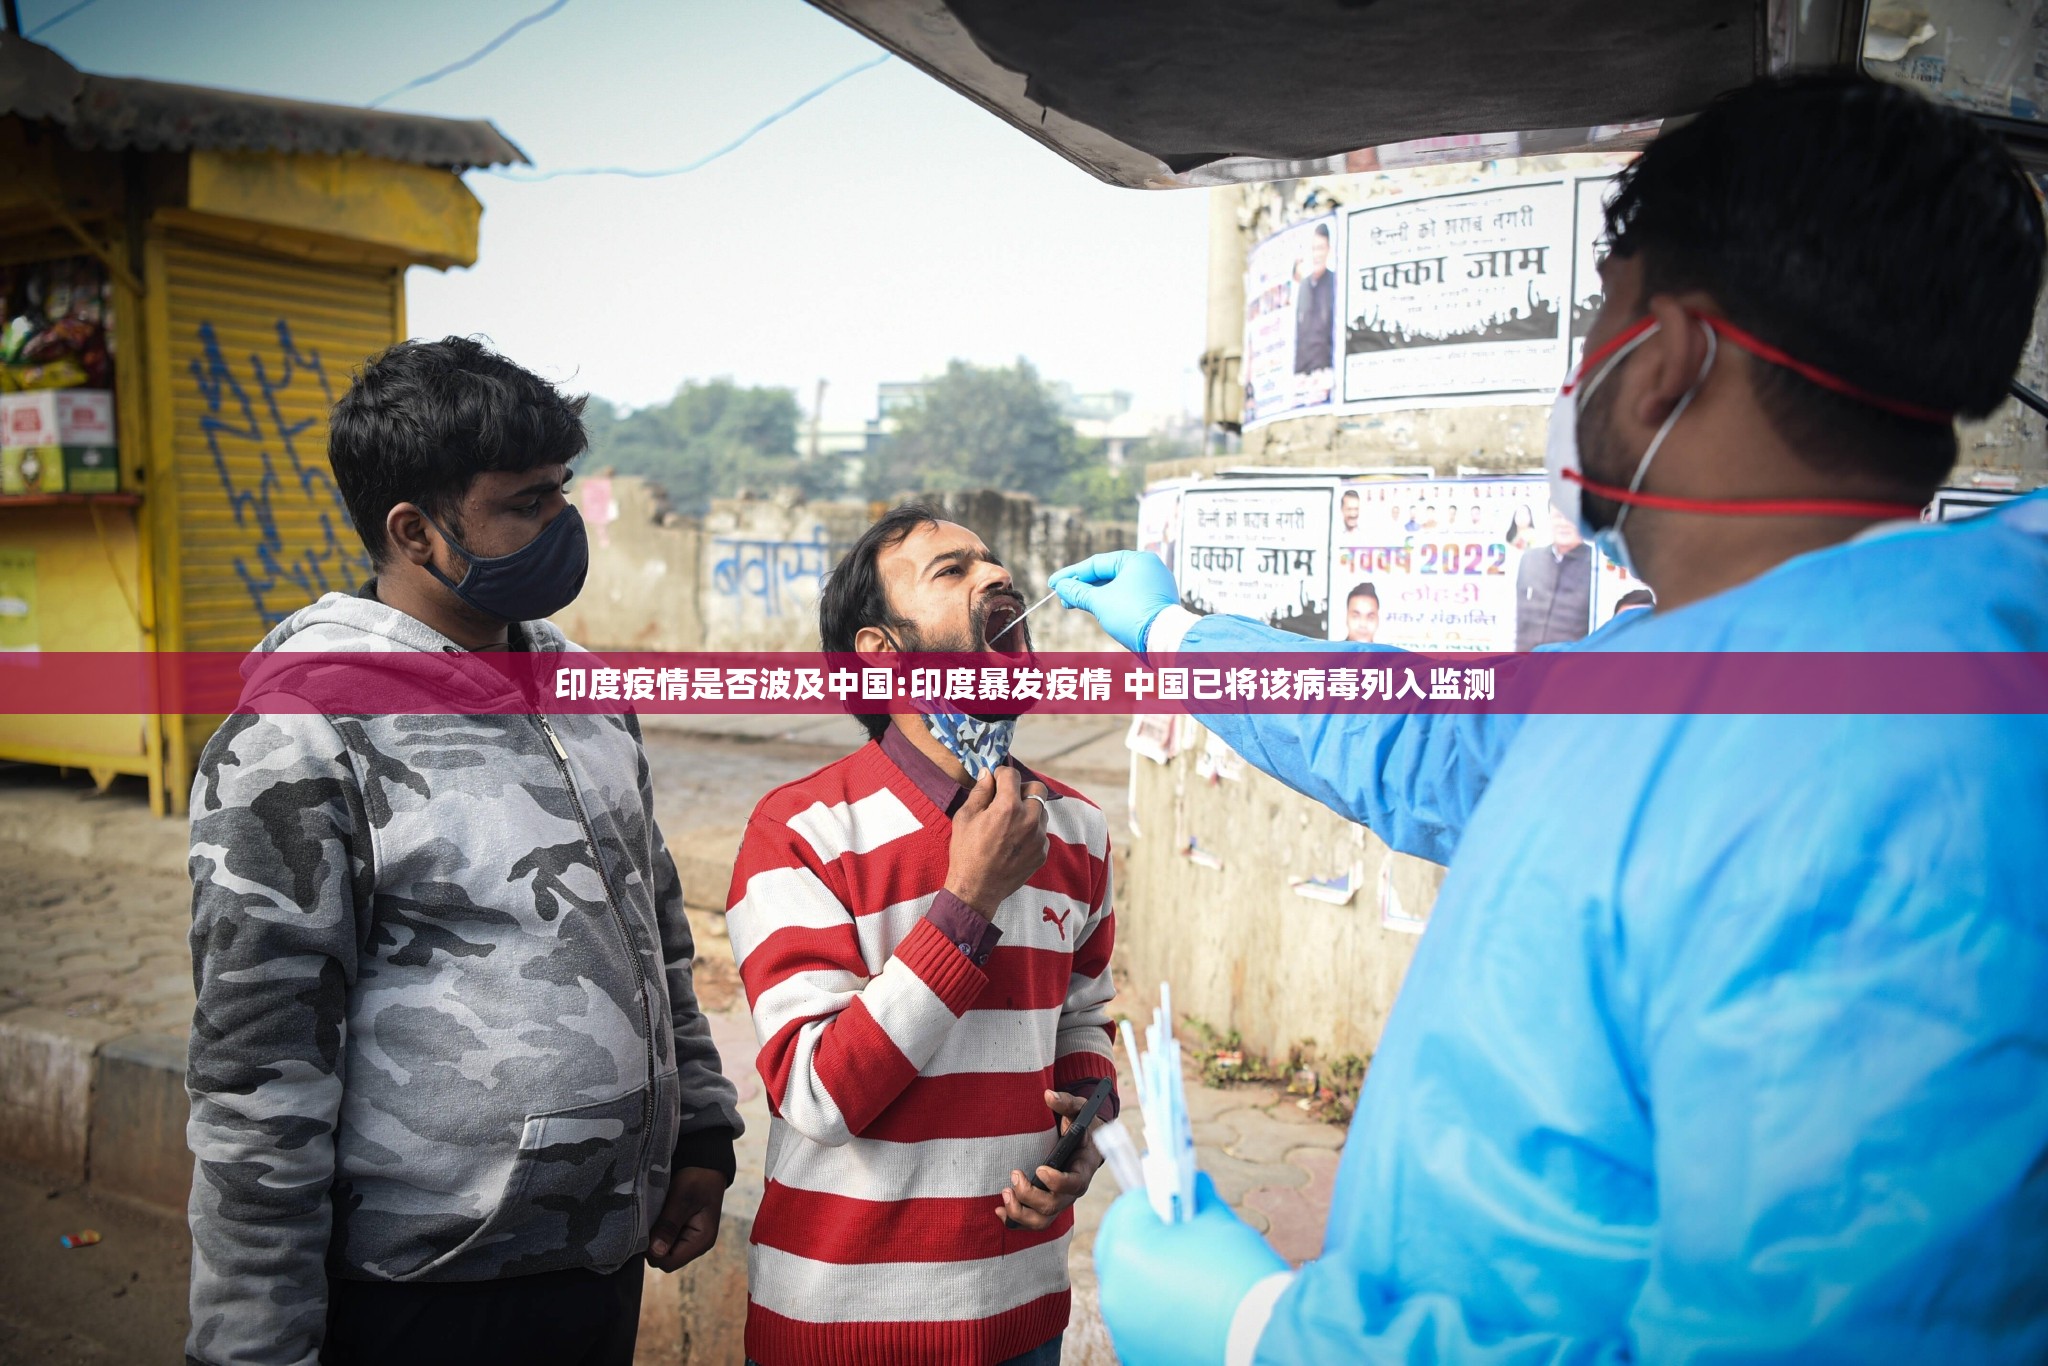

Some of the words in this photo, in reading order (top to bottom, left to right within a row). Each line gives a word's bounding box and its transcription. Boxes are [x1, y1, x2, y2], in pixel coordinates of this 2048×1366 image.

[1359, 256, 1448, 292] चक्का
[1463, 246, 1550, 279] जाम
[1189, 545, 1245, 574] चक्का
[1255, 546, 1317, 577] जाम
[1339, 535, 1415, 575] नववर्ष
[1420, 543, 1507, 576] 2022
